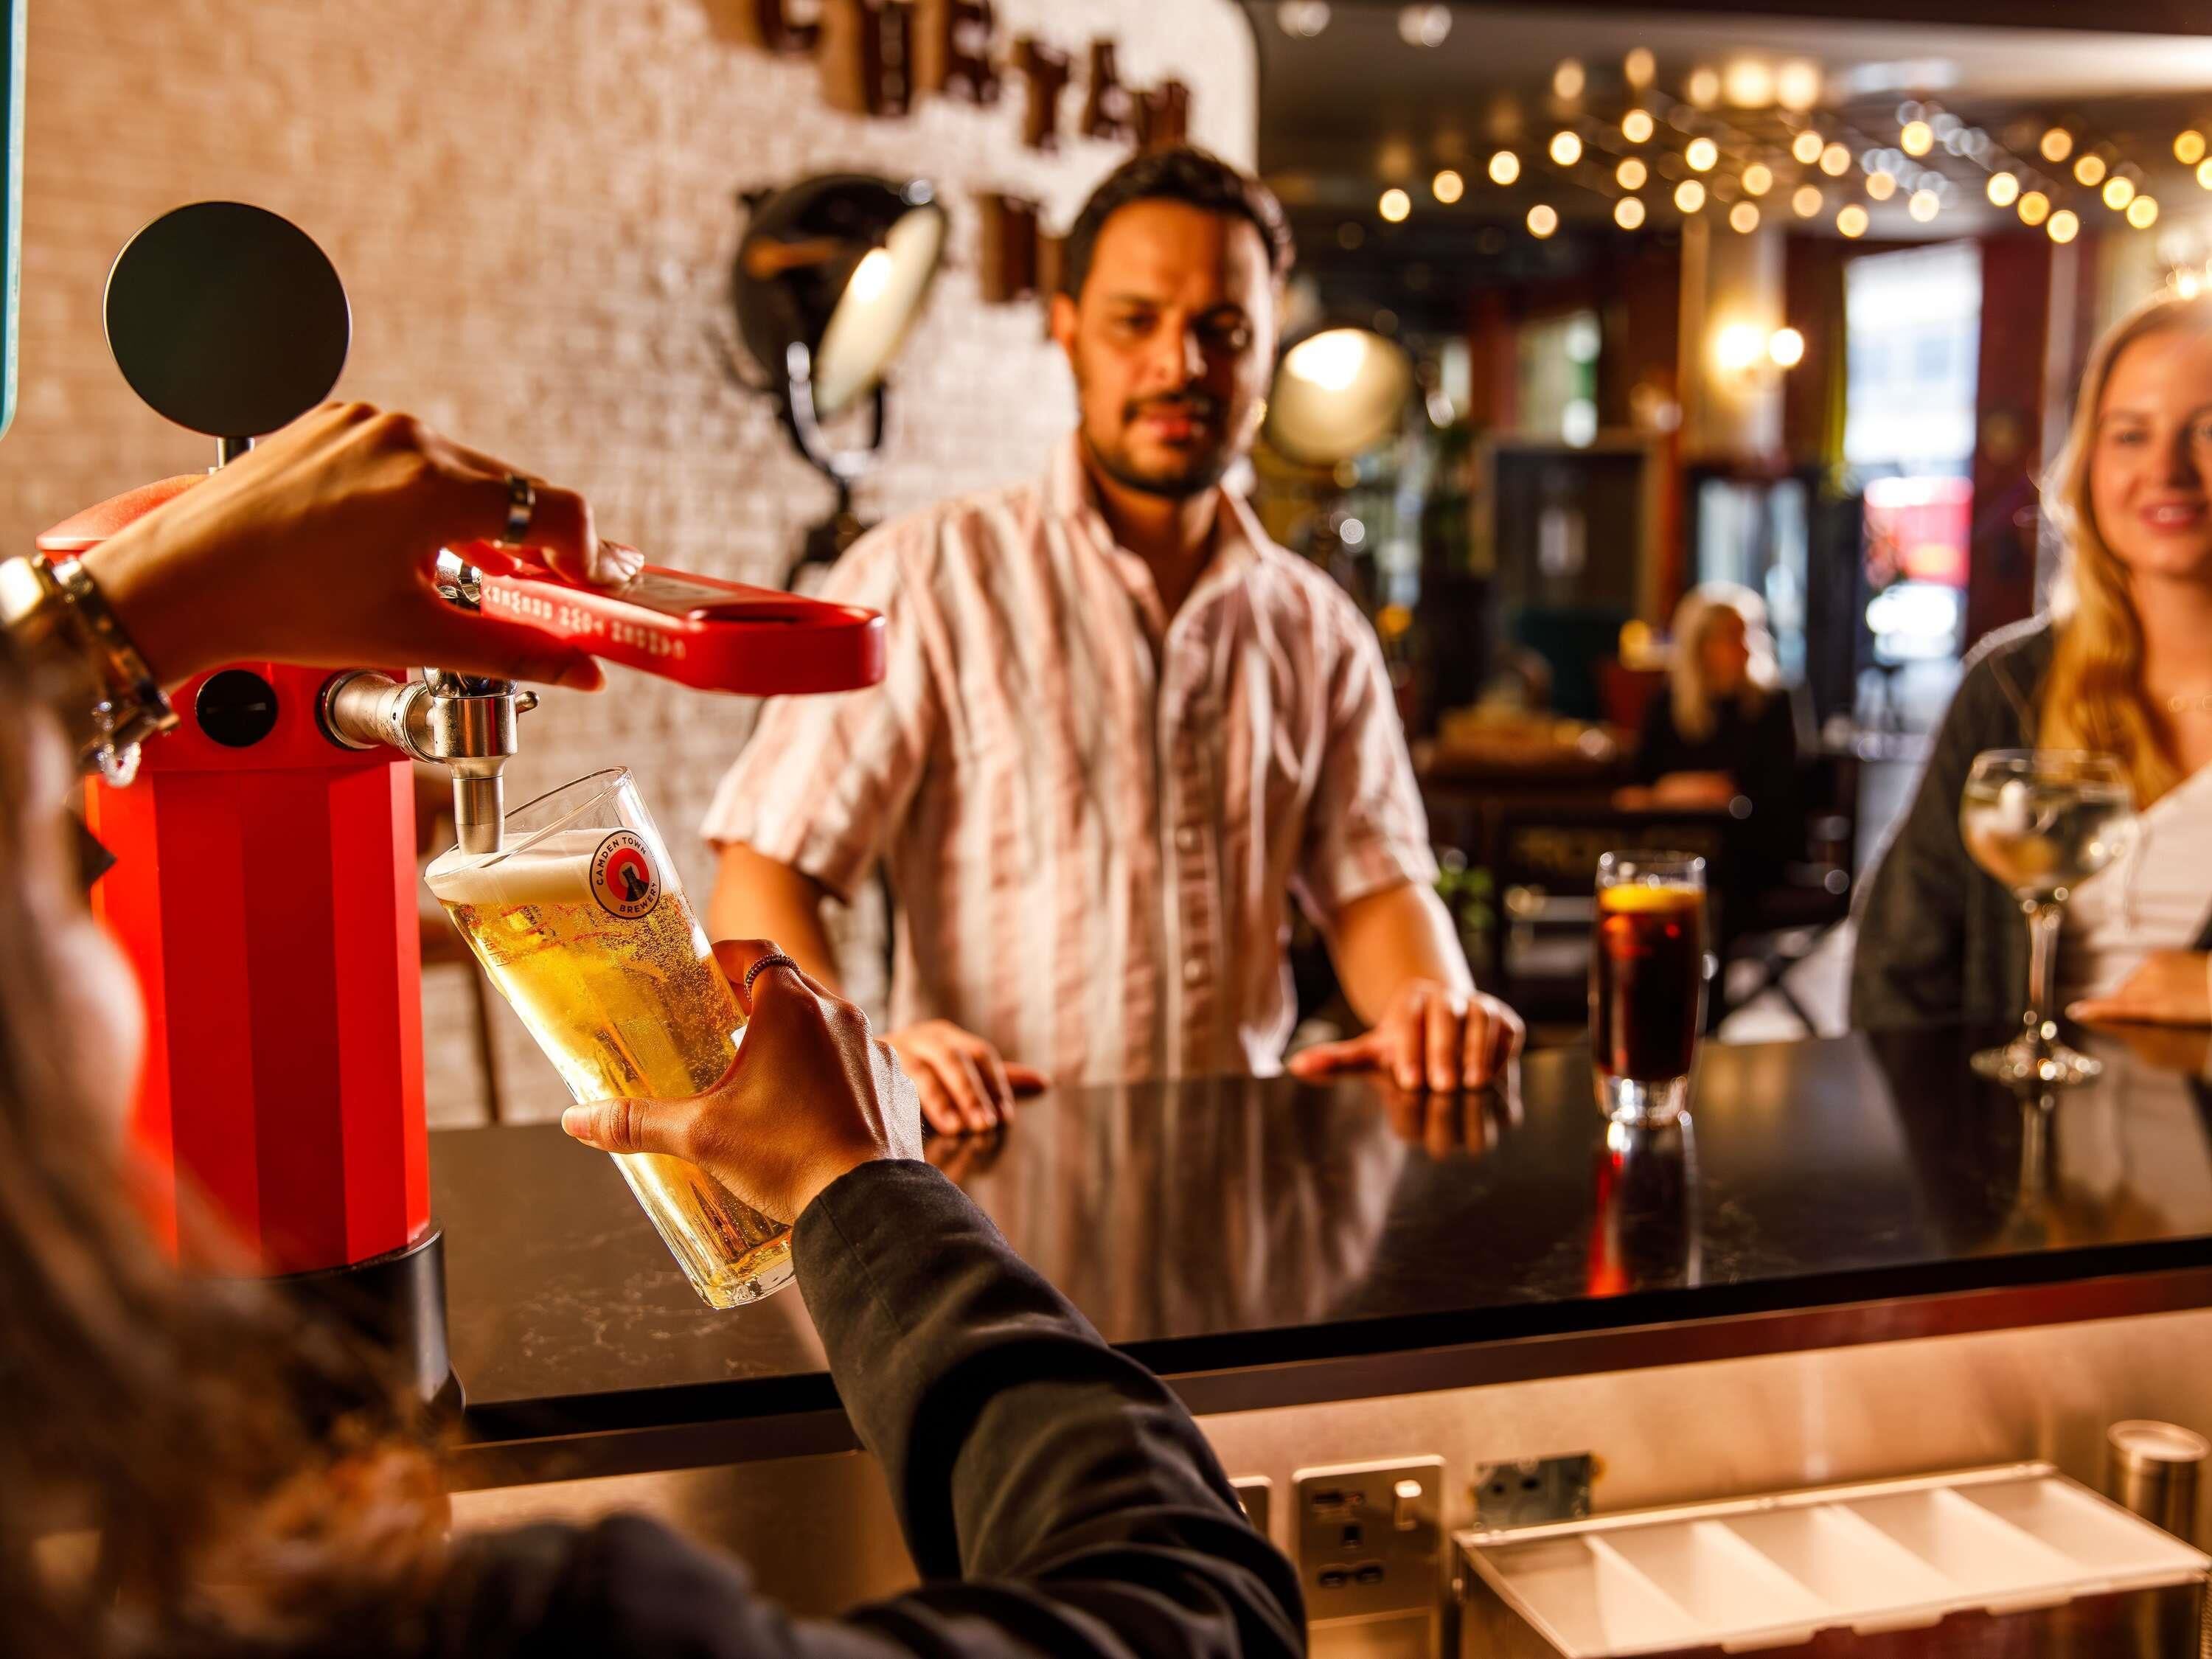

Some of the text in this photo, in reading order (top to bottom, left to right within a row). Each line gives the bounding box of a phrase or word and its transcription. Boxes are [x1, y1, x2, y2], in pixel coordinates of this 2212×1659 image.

[596, 837, 646, 886] CAMDEN TOWN
[619, 880, 657, 914] BREWERY
